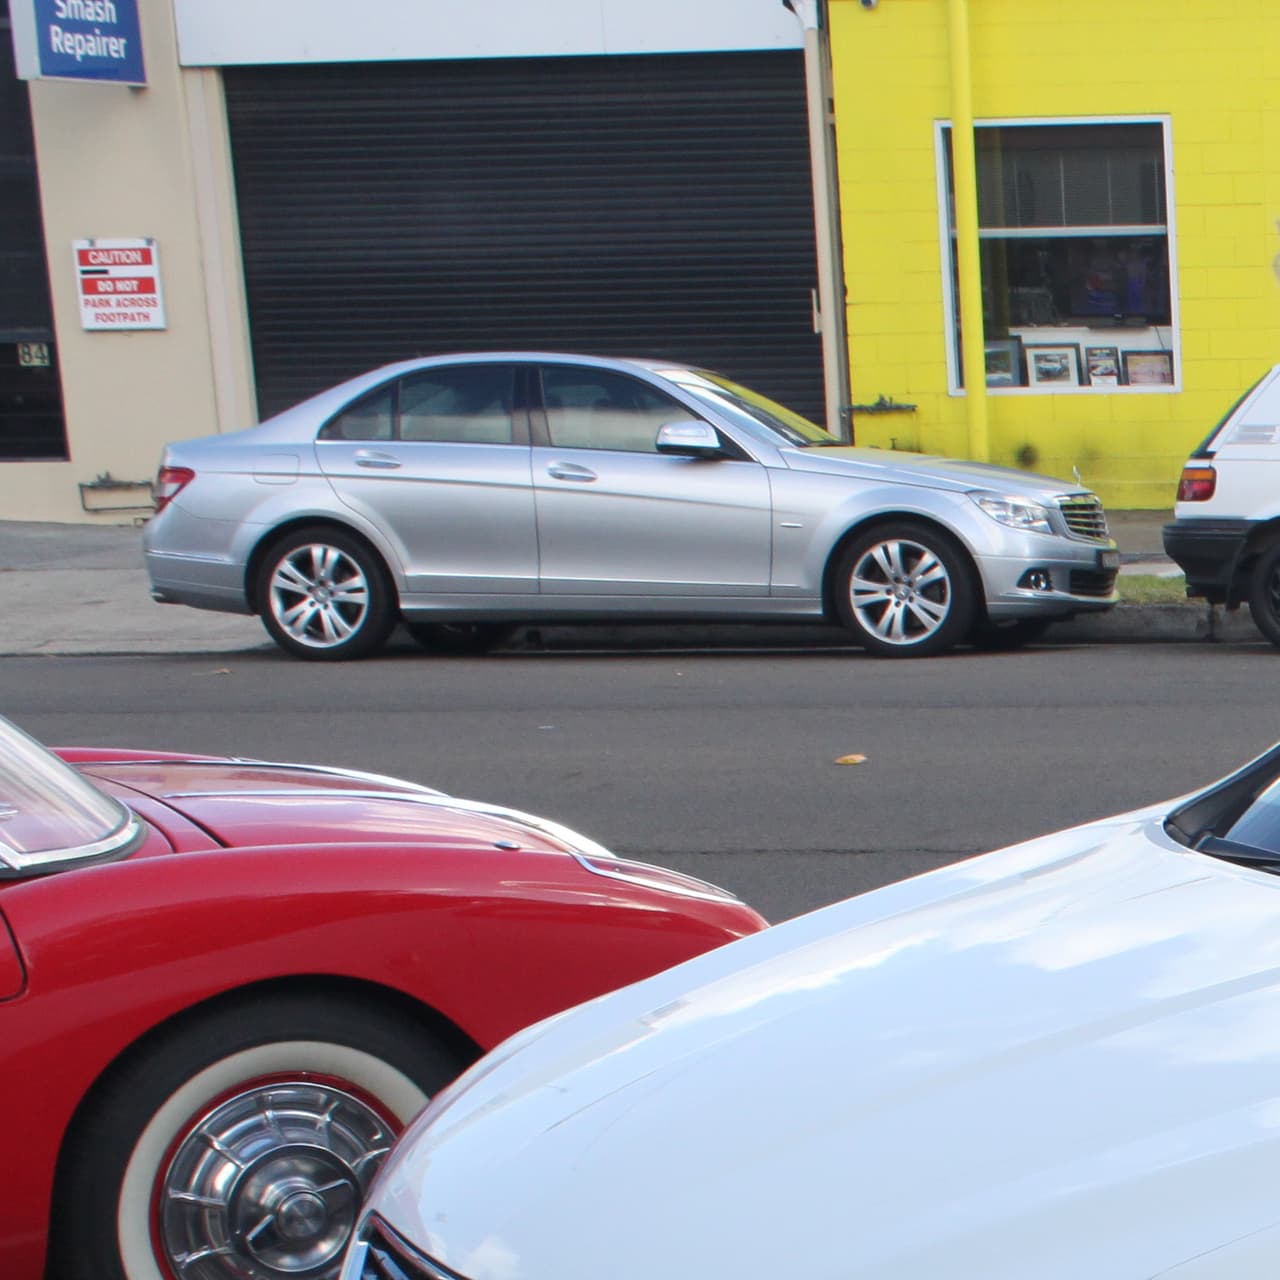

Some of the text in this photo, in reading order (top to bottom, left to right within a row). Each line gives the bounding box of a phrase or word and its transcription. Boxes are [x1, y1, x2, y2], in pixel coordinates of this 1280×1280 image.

[55, 0, 117, 24] Smash
[49, 24, 128, 62] Repairer
[88, 250, 143, 264] CAUTION
[96, 280, 139, 292] DO NOT
[84, 297, 158, 308] PARK ACROSS
[95, 311, 151, 323] FOOTPATH
[20, 343, 49, 365] 84
